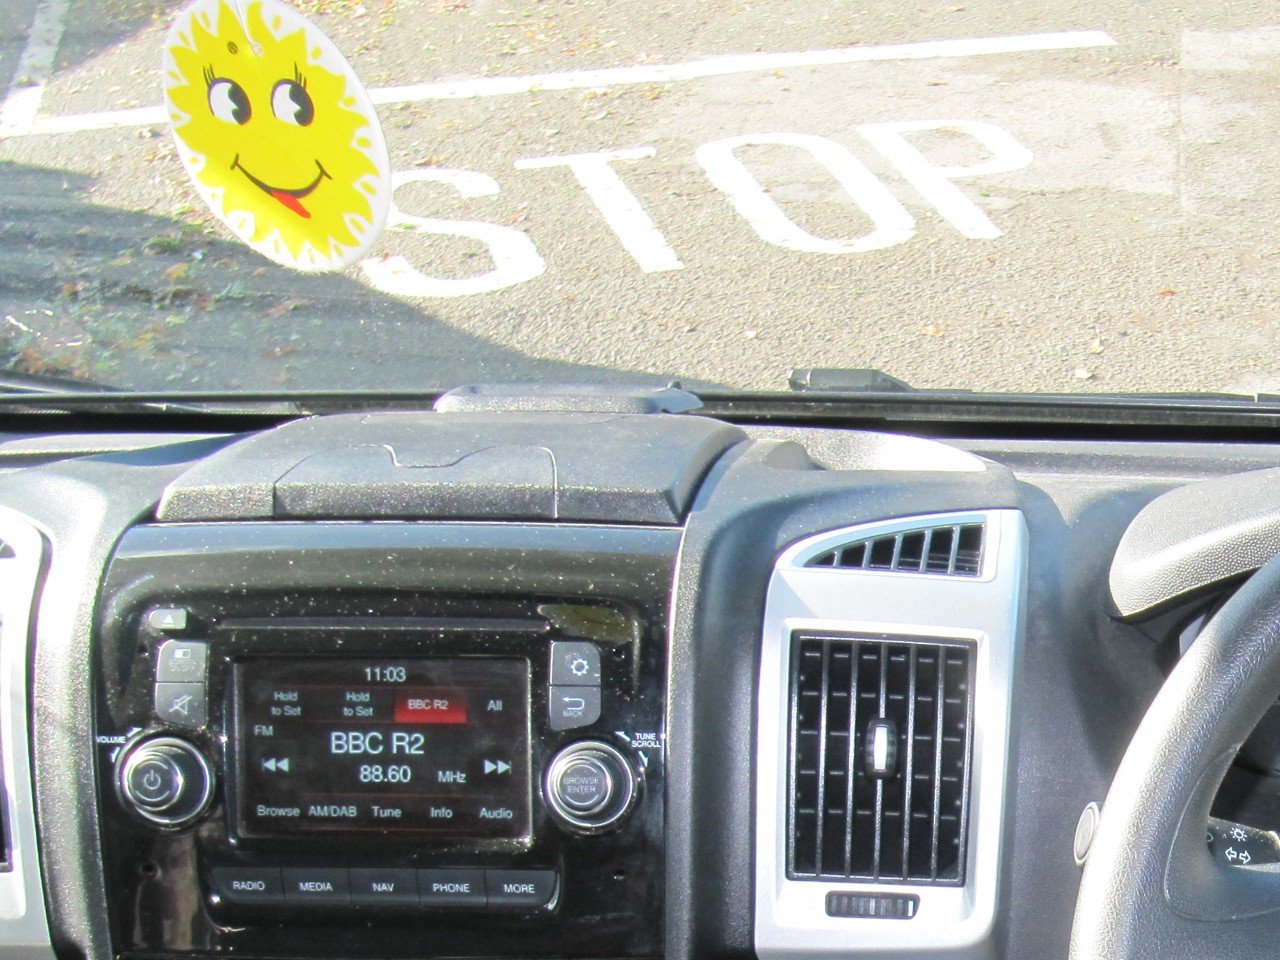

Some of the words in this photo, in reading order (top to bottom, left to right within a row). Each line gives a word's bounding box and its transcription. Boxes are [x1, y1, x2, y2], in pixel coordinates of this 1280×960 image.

[361, 118, 1035, 298] STOP
[364, 667, 407, 682] 11:03
[274, 691, 298, 701] Hold
[346, 691, 370, 702] Hold
[408, 699, 430, 710] BBC
[432, 699, 449, 710] R2
[487, 700, 503, 711] All
[271, 706, 281, 716] to
[284, 706, 302, 716] Set
[343, 706, 354, 717] to
[356, 706, 373, 717] Set
[254, 725, 274, 736] FM
[96, 736, 126, 744] VOLUME
[330, 732, 384, 754] BBC
[392, 733, 425, 754] R2
[631, 740, 662, 748] SCROLL
[359, 765, 412, 783] 88.60
[438, 771, 467, 783] MHz
[257, 805, 300, 816] Browse
[372, 806, 401, 817] Tune
[430, 806, 453, 818] Info
[479, 807, 513, 819] Audio
[232, 881, 265, 891] RADIO
[300, 882, 333, 892] MEDIA
[373, 883, 394, 893] NAV
[433, 883, 470, 893] PHONE
[504, 884, 535, 894] MORE
